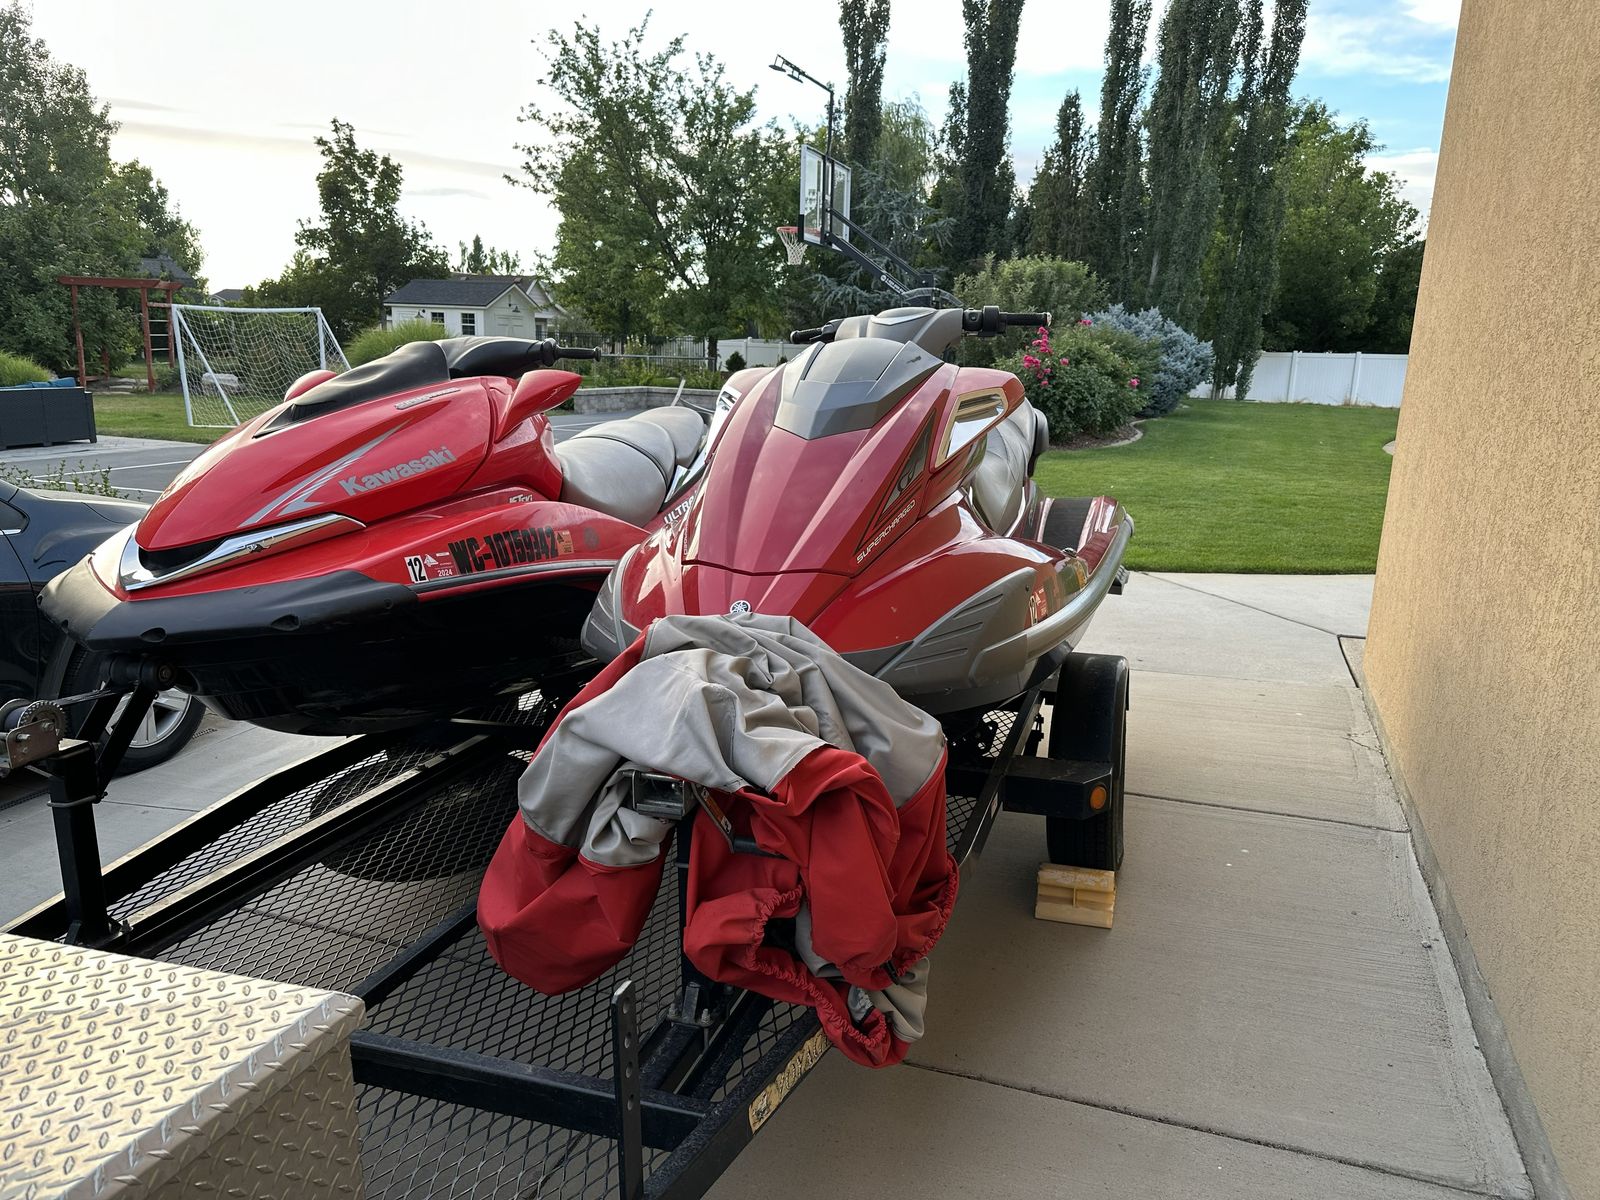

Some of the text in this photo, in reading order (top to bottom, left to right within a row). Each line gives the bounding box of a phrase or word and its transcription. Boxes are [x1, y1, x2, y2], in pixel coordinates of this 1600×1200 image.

[339, 446, 457, 496] Kawasaki
[856, 499, 916, 564] SUPERCHARGED
[408, 557, 427, 582] 12
[437, 568, 453, 577] 2024
